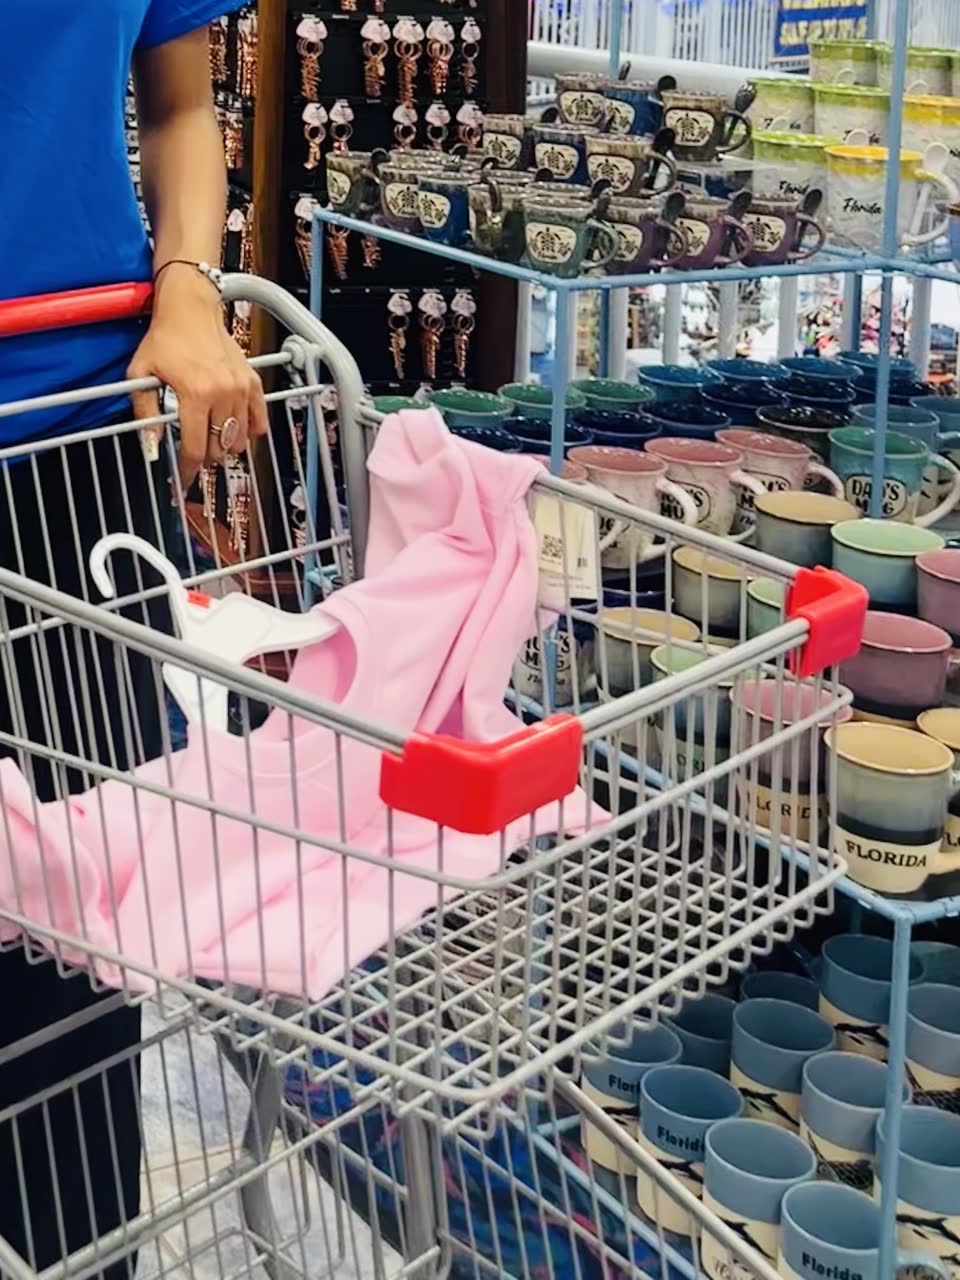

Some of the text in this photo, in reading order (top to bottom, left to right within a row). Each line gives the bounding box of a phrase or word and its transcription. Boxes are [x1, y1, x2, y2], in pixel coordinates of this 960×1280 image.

[843, 197, 884, 215] Florida
[852, 479, 900, 502] DA'S
[855, 498, 894, 515] MG
[845, 839, 928, 868] FLORIDA
[656, 1124, 706, 1153] Florid
[800, 1251, 863, 1280] Florida
